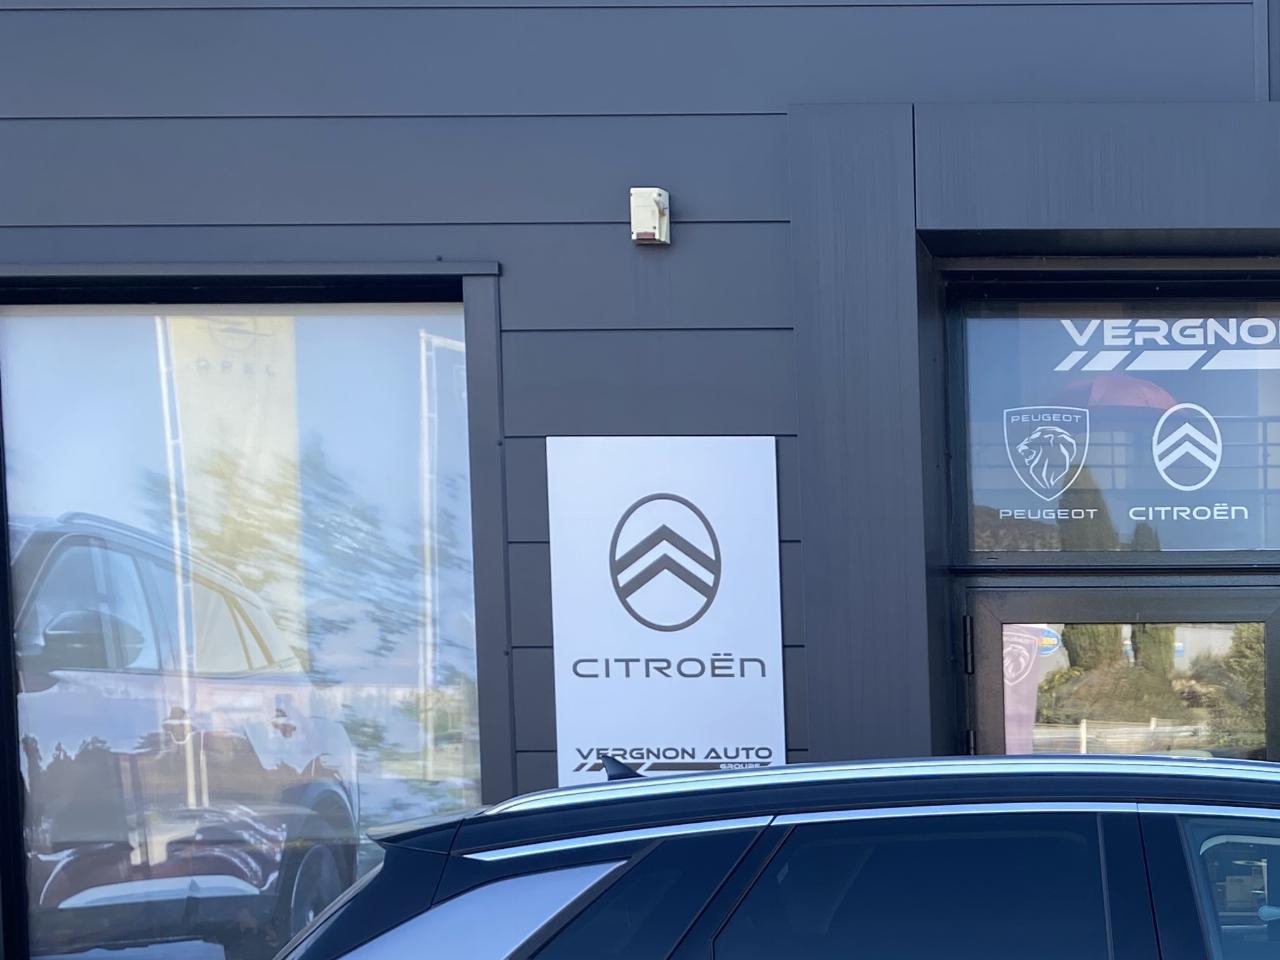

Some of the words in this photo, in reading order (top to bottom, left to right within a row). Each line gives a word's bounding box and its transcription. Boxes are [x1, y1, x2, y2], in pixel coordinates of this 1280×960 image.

[1010, 412, 1082, 424] PEUGEOT
[999, 508, 1099, 520] PEUGEOT
[575, 747, 696, 761] VERGNON
[704, 746, 774, 760] AUTO
